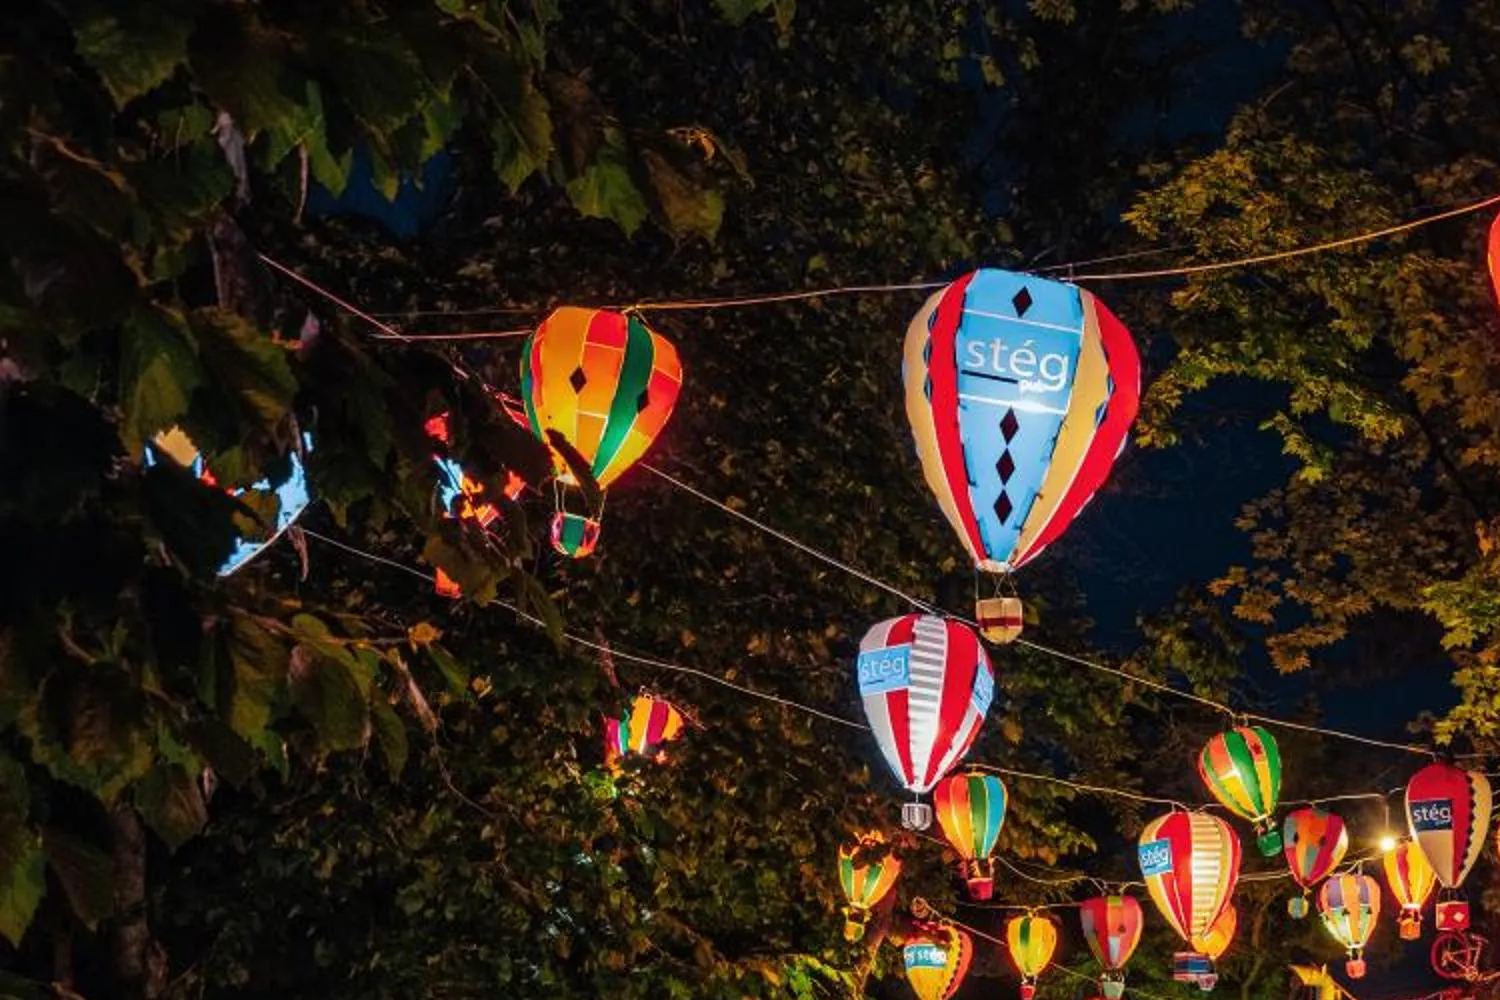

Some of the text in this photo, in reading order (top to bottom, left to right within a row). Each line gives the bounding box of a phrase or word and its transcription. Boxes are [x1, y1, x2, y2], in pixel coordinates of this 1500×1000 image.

[965, 337, 1079, 392] stég
[860, 650, 906, 680] stég
[1413, 803, 1451, 824] stég
